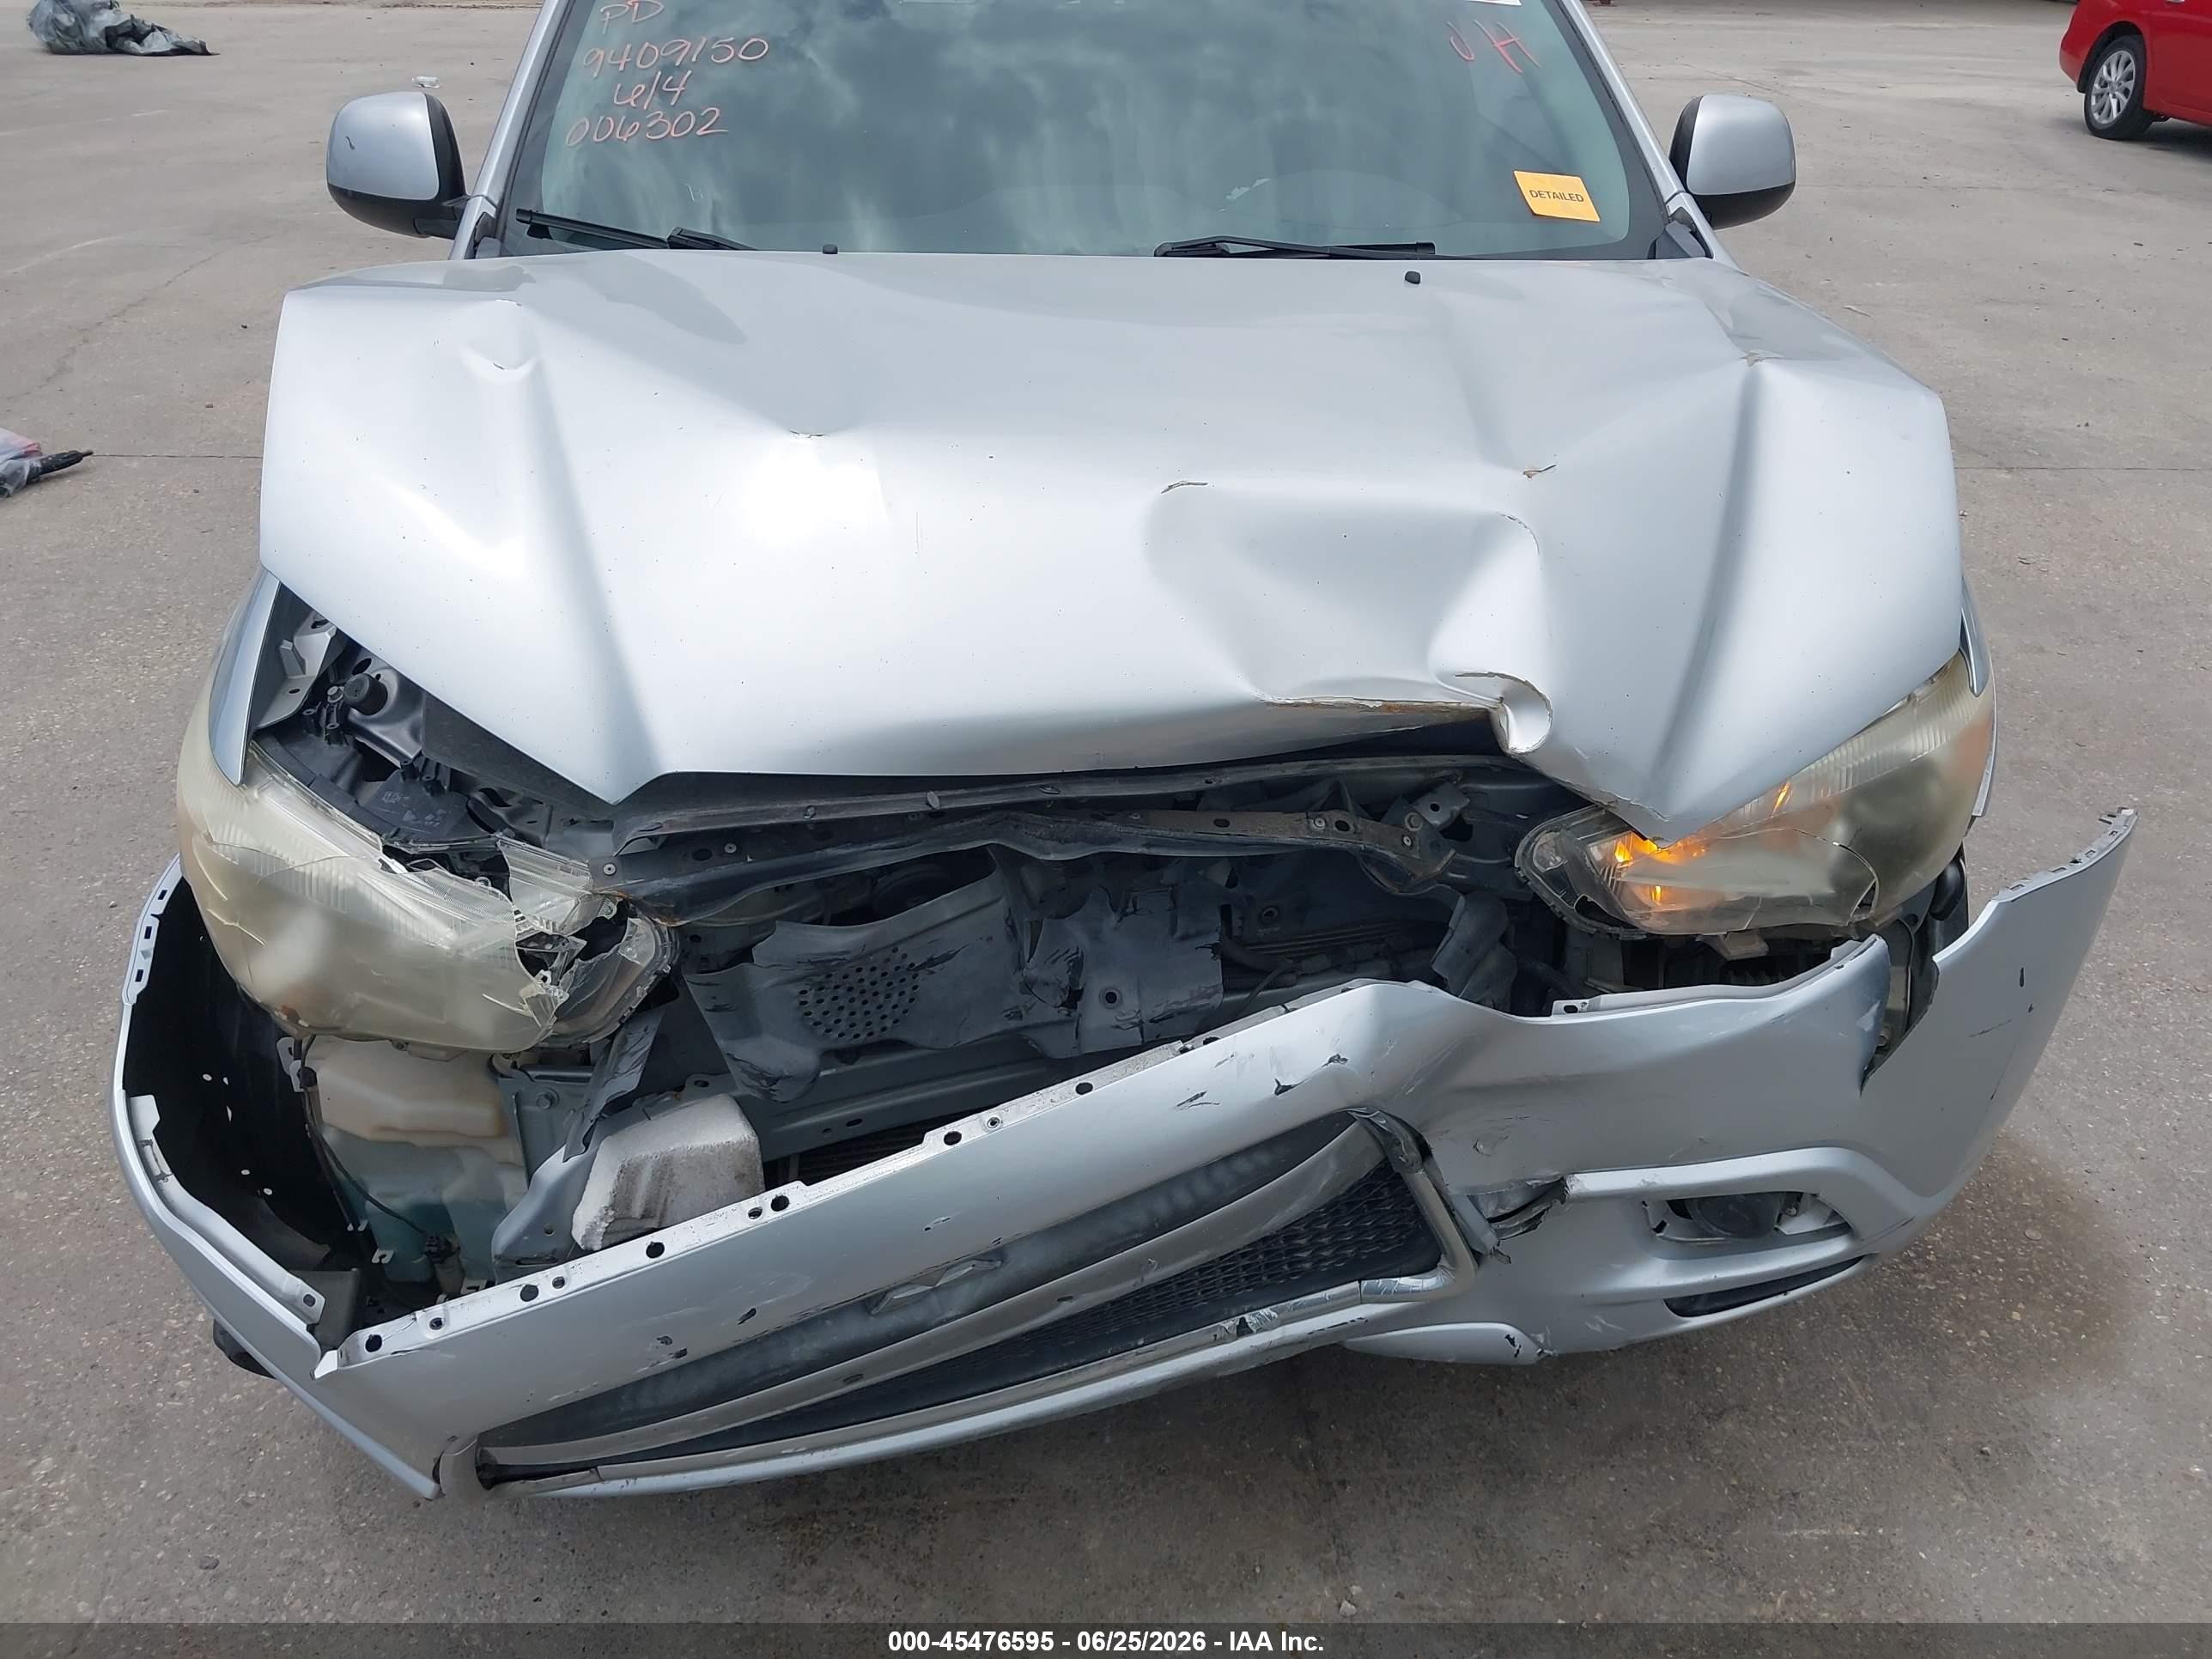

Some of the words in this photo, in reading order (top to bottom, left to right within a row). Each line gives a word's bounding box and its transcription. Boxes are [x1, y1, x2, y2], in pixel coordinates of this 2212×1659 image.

[601, 1, 665, 34] PD
[583, 38, 769, 77] 9409150
[566, 106, 729, 147] 006302
[1528, 189, 1584, 203] DETAILED
